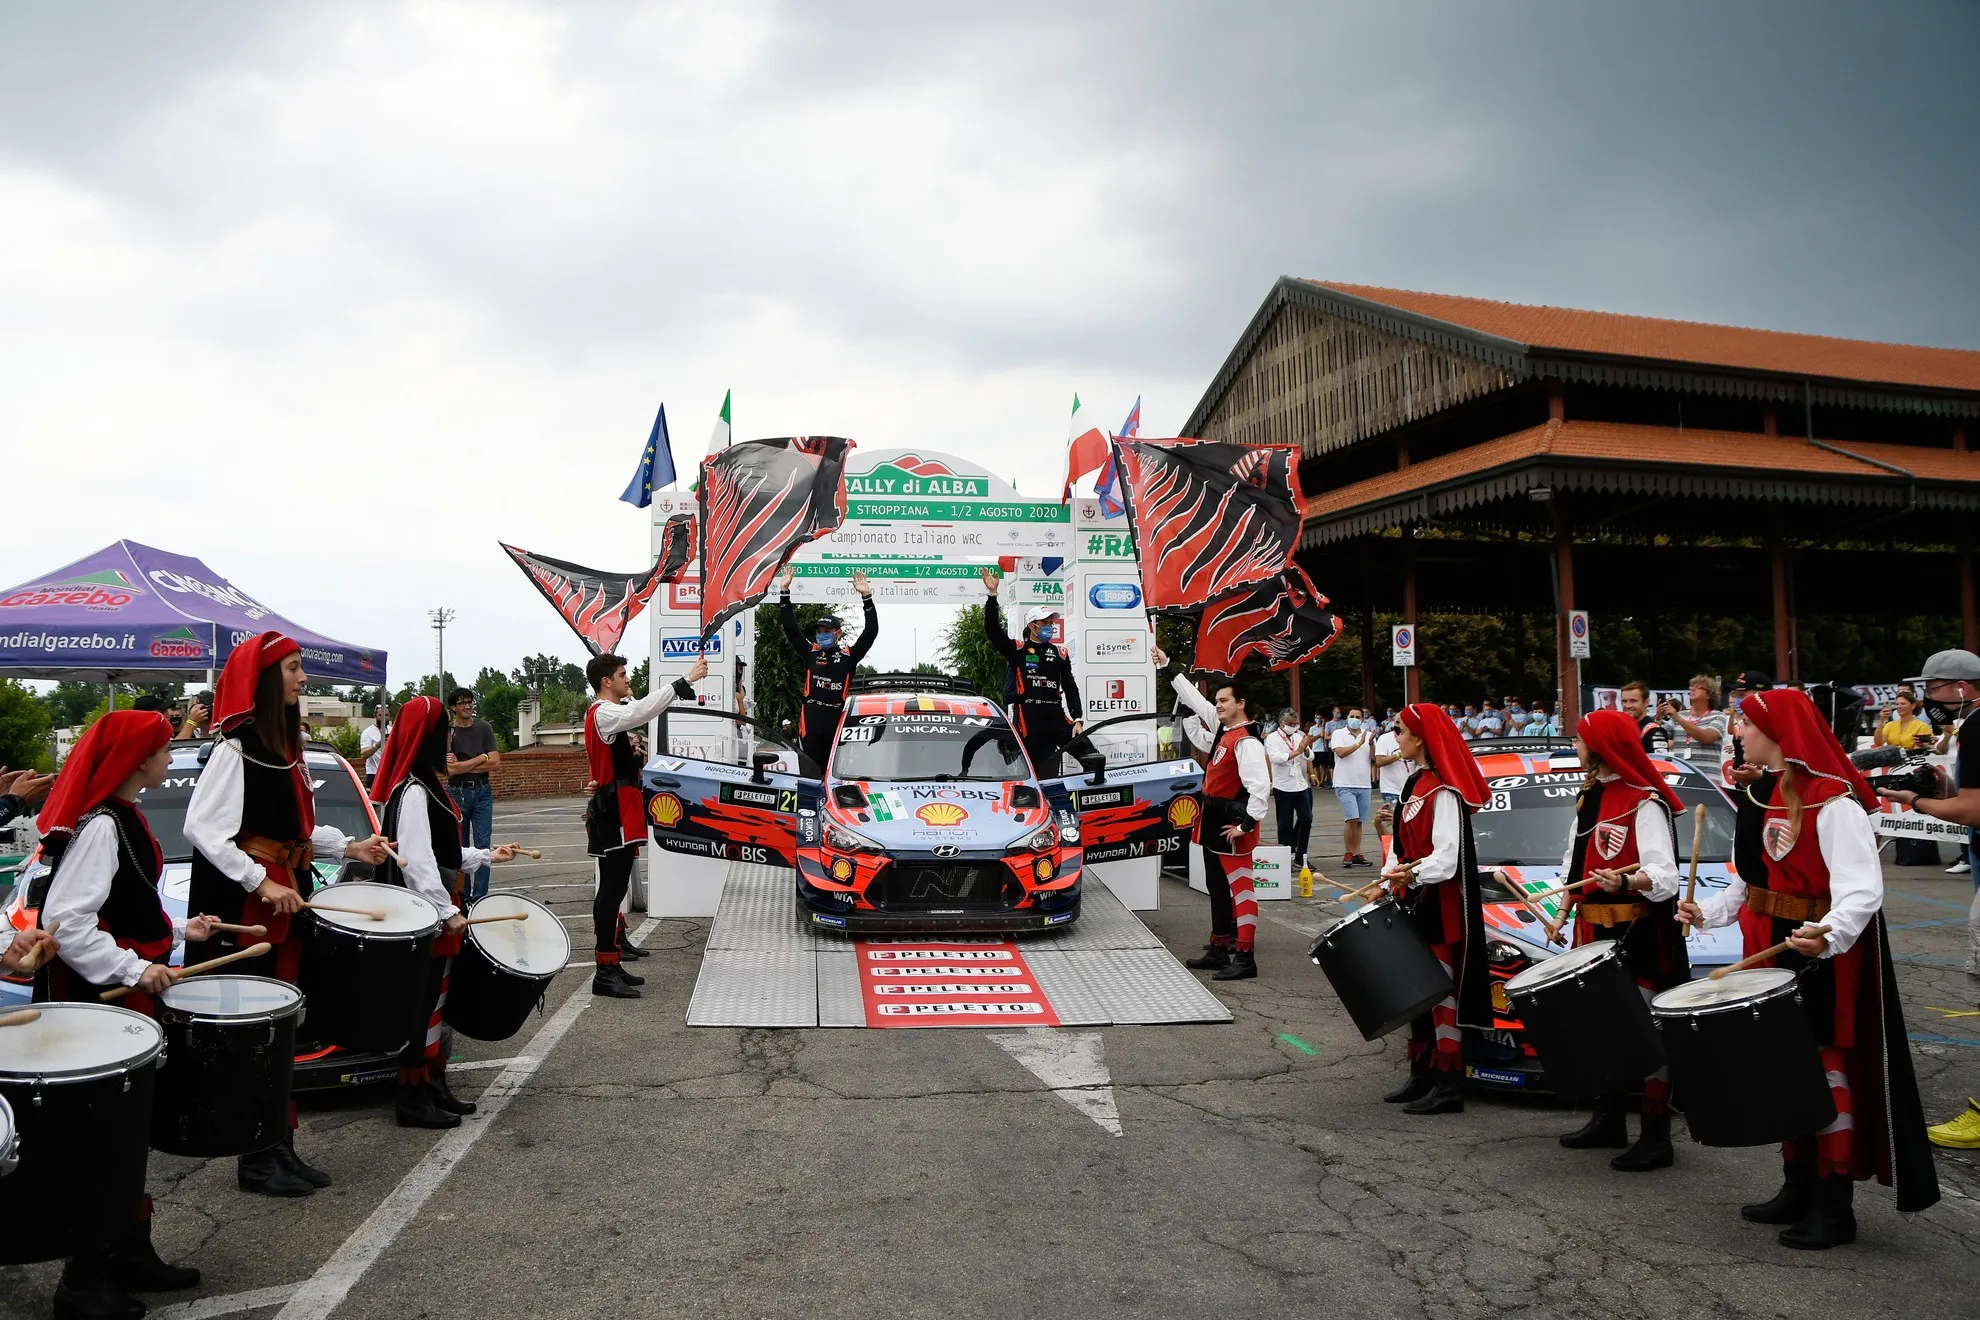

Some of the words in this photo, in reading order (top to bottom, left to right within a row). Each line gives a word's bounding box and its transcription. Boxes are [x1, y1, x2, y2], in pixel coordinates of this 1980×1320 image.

[902, 479, 920, 493] di
[927, 480, 978, 495] ALBA
[856, 504, 929, 516] STROPPIANA
[951, 505, 972, 517] 1/2
[978, 507, 1023, 518] AGOSTO
[1029, 507, 1058, 518] 2020
[830, 530, 897, 549] Campionato
[904, 532, 956, 545] Italiano
[962, 533, 983, 545] WRC
[807, 566, 841, 575] SILVIO
[845, 567, 899, 576] STROPPIANA
[915, 567, 931, 576] 1/2
[936, 568, 969, 576] AGOSTO
[40, 585, 96, 593] Mondial
[880, 585, 919, 596] Italiano
[923, 586, 939, 597] WRC
[0, 589, 131, 607] Gazebo
[150, 642, 202, 658] Gazebo
[664, 640, 719, 652] AVIGEL
[1096, 643, 1132, 652] elsynet
[816, 680, 843, 691] MOBIS
[1032, 680, 1057, 689] MOBIS
[1089, 700, 1137, 710] PELETTO
[891, 715, 956, 723] HYUNDAI
[843, 728, 870, 741] 211
[895, 725, 948, 734] UNICAR
[672, 737, 691, 746] Pasta
[1110, 750, 1145, 761] integra
[704, 765, 749, 777] INNOCEAN
[1107, 767, 1149, 779] INNOCEAN
[743, 792, 772, 803] PELETTO
[912, 790, 1001, 800] MOBIS
[1089, 794, 1118, 804] PELETTO
[805, 818, 814, 842] EUKOR
[1880, 817, 1925, 834] impianti
[1926, 822, 1945, 835] gas
[666, 838, 708, 852] HYUNDAI
[710, 841, 768, 864] MOBIS
[1086, 847, 1127, 861] HYUNDAI
[1129, 836, 1181, 858] MOBIS
[916, 1004, 1024, 1012] PELETTO
[1480, 1072, 1520, 1082] MICHELIN
